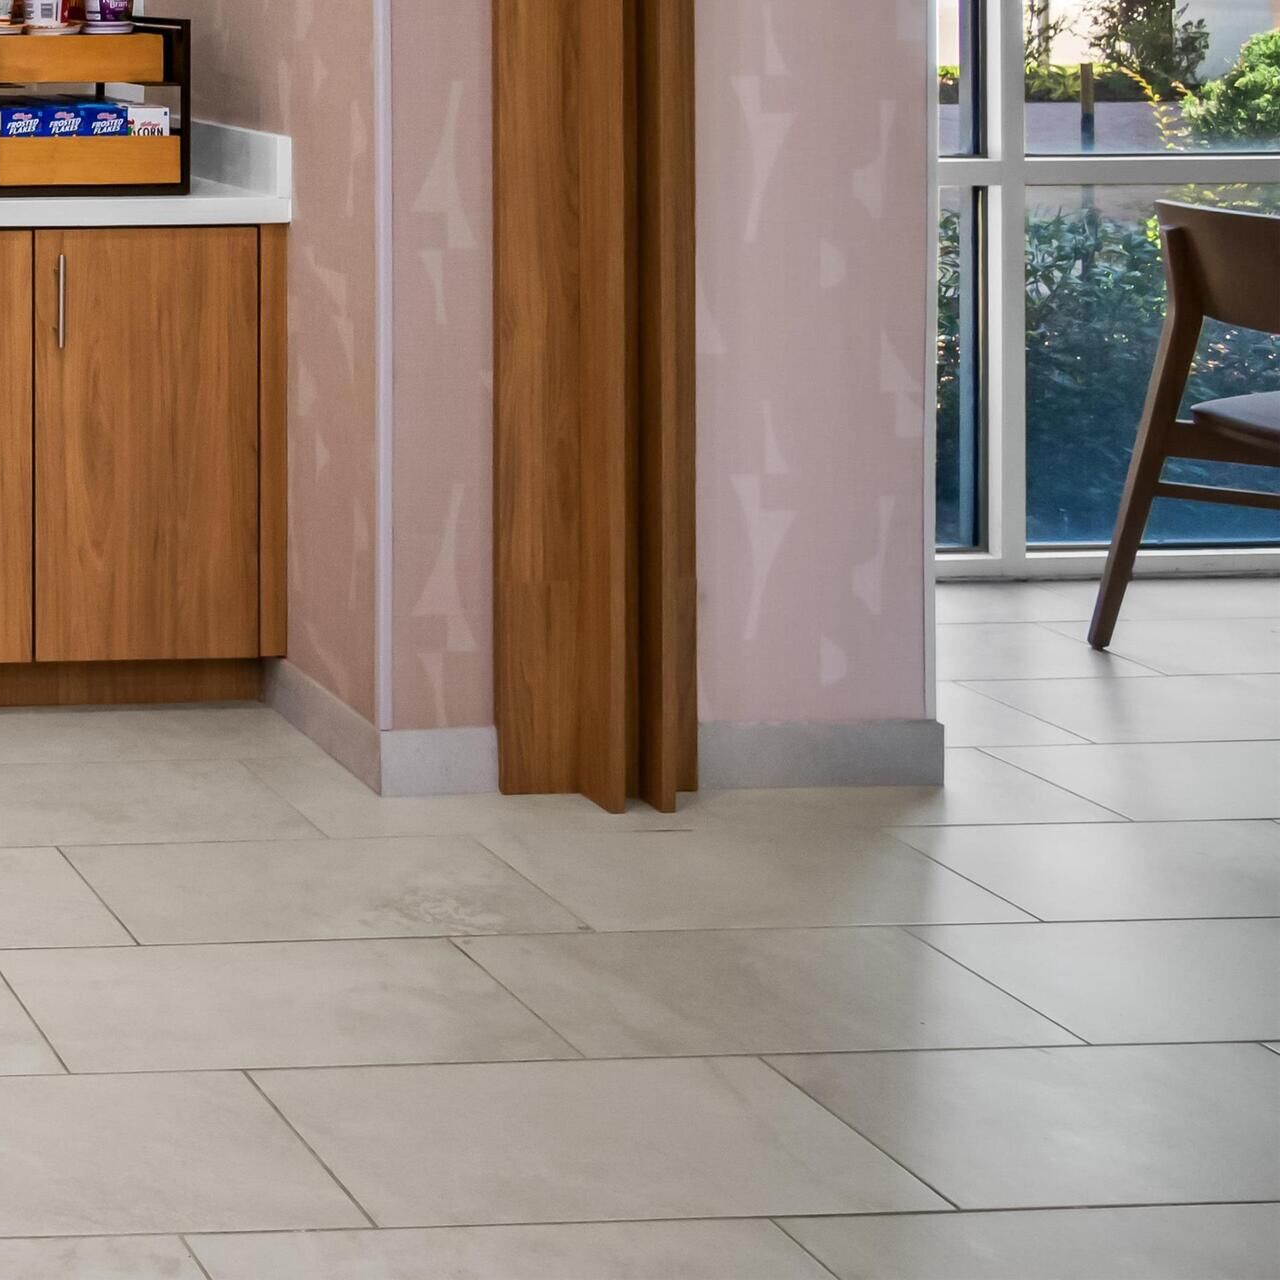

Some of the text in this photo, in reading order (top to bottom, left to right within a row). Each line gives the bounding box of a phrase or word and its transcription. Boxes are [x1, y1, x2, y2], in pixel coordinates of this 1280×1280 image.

[109, 0, 128, 8] Bran
[7, 119, 39, 129] FROSTED
[49, 118, 82, 128] FROSTED
[91, 119, 124, 129] FROSTED
[9, 125, 35, 135] FLAKES
[51, 124, 78, 134] FLAKES
[93, 125, 120, 135] FLAKES
